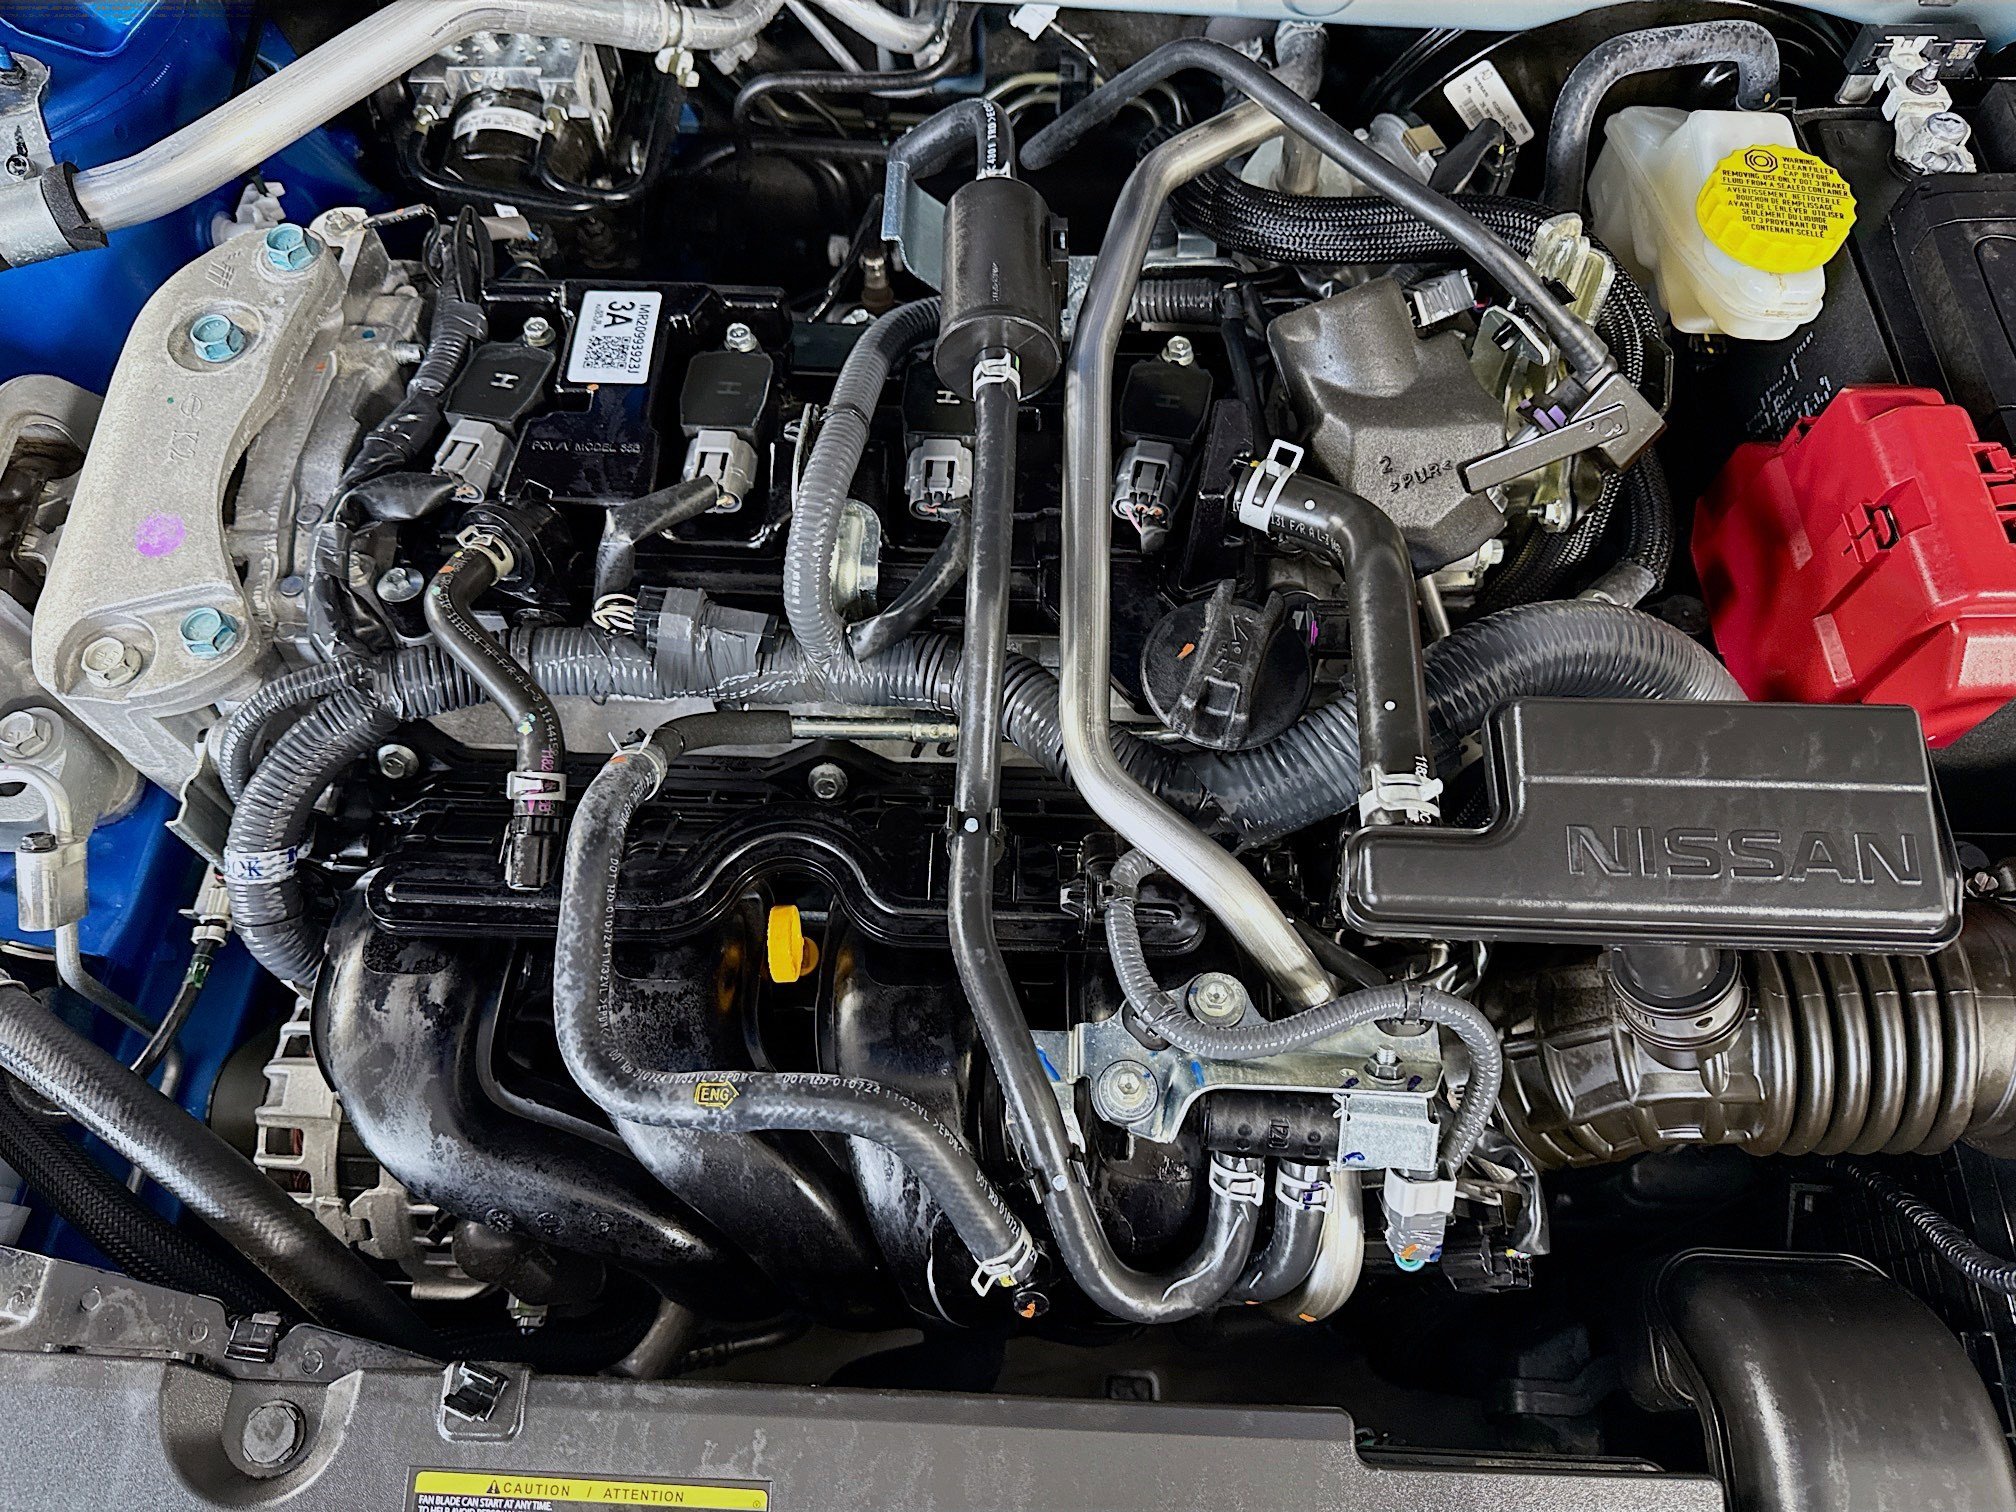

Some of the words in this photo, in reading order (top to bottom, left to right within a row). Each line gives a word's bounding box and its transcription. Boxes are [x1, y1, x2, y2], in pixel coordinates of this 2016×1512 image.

[1783, 163, 1807, 173] CLEAN
[1808, 167, 1834, 175] FILLER
[1803, 172, 1828, 181] BEFORE
[1746, 179, 1767, 187] FROM
[1777, 182, 1806, 192] SEALED
[1808, 186, 1848, 197] CONTAINER
[1778, 175, 1796, 183] ONLY
[1822, 181, 1846, 190] BRAKE
[1736, 194, 1769, 203] BOUCHON
[1782, 198, 1833, 211] REMPLISSAGE
[1792, 193, 1830, 204] NETTOYER
[1728, 200, 1754, 208] AVANT
[1812, 209, 1844, 219] UTILISER
[1741, 208, 1785, 219] SEULEMENT
[1799, 215, 1827, 224] LIQUIDE
[1742, 215, 1756, 223] DOT
[1765, 217, 1809, 229] PROVENANT
[1751, 223, 1794, 235] CONTENANT
[1796, 228, 1825, 239] SCELLÉ
[603, 301, 636, 328] 3A
[1379, 455, 1394, 475] 2
[1565, 823, 1923, 886] NISSAN
[609, 858, 619, 880] DOT
[603, 906, 614, 948] 010724
[782, 1074, 804, 1084] DOT
[832, 1077, 881, 1095] 010724
[700, 1088, 730, 1102] ENG
[503, 1482, 570, 1496] CAUTION
[603, 1488, 685, 1503] ATTENTION
[418, 1495, 435, 1505] FAN
[435, 1495, 461, 1507] BLADE
[461, 1497, 479, 1507] CAN
[480, 1498, 504, 1508] START
[503, 1499, 514, 1509] AT
[514, 1500, 533, 1510] ANY
